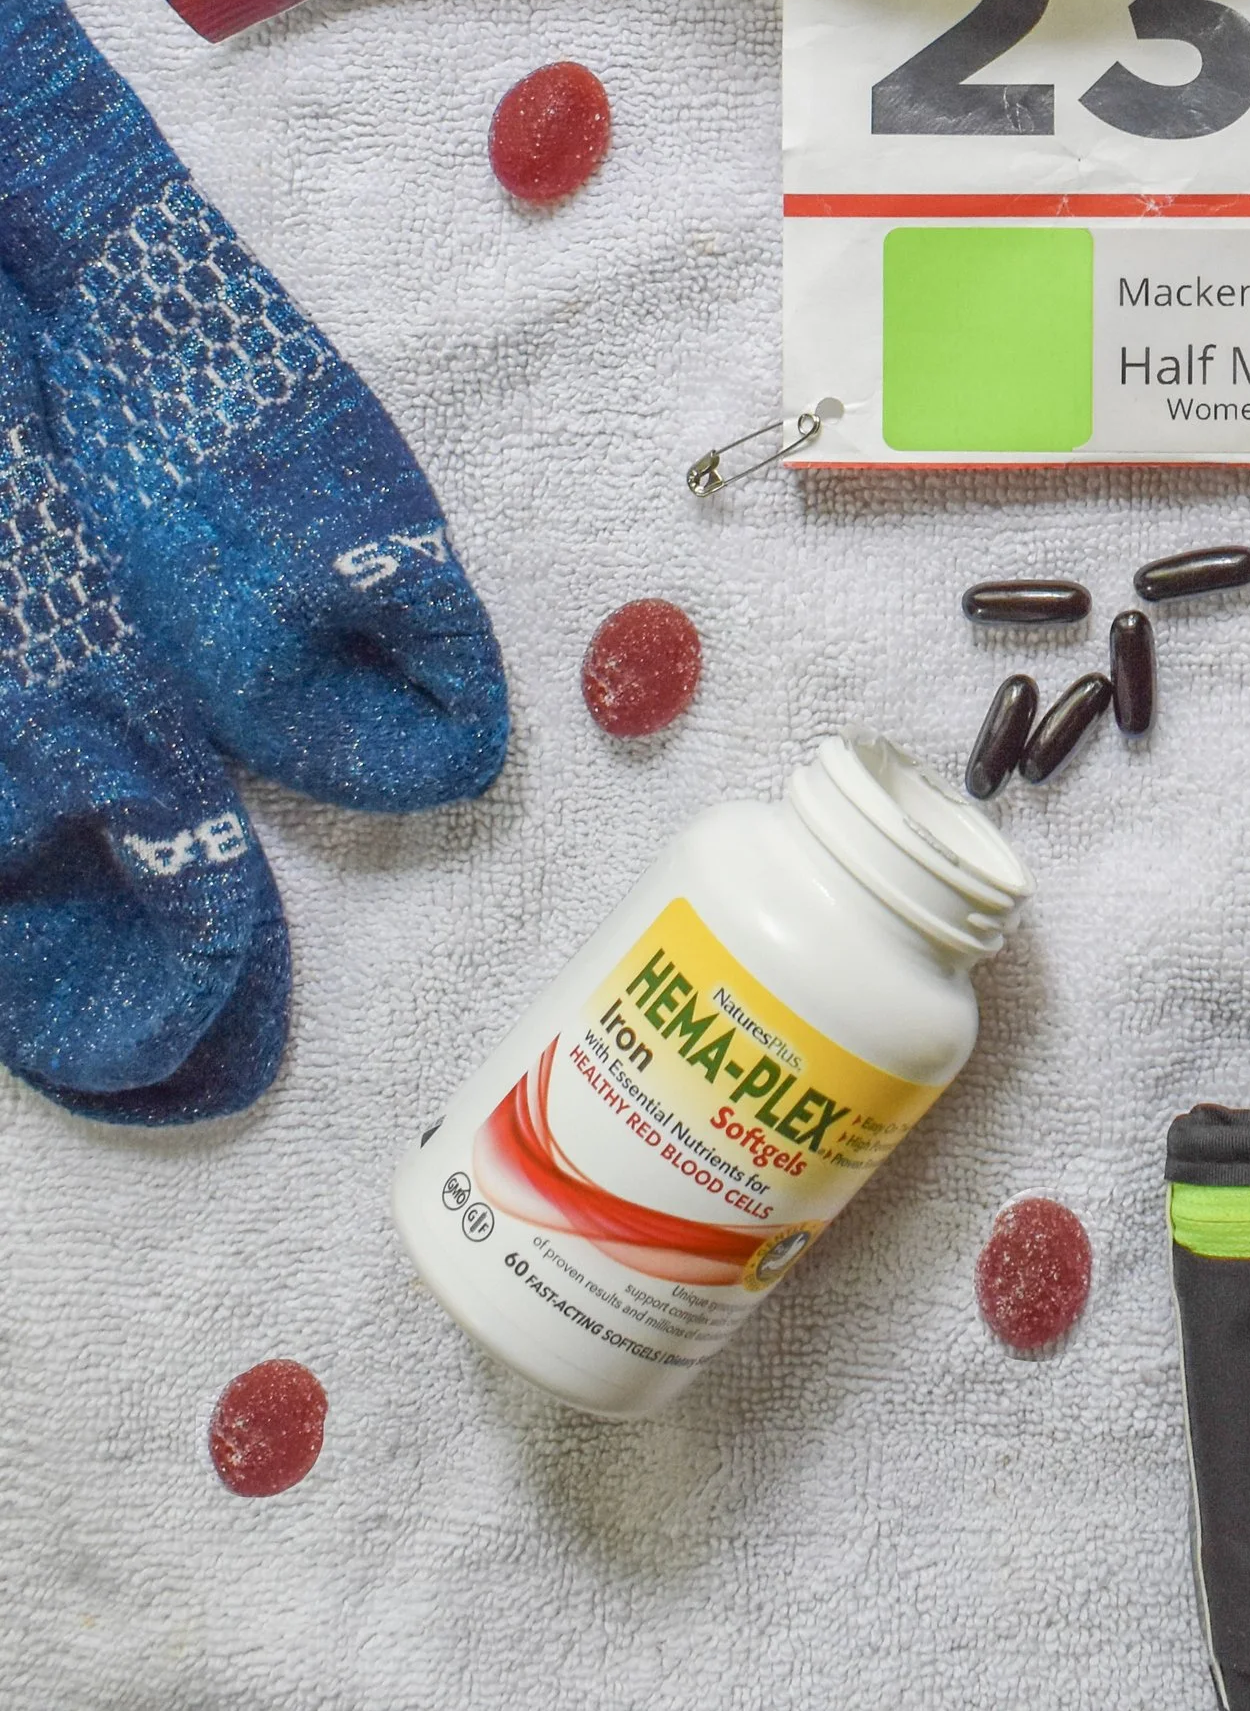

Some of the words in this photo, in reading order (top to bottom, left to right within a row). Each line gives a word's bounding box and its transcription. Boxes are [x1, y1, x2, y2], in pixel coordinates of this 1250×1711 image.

[1120, 343, 1217, 386] Half
[599, 997, 654, 1073] Iron
[625, 948, 852, 1153] HEMA-PLEX
[569, 1044, 631, 1116] HEALTHY
[625, 1111, 662, 1148] RED
[659, 1141, 724, 1194] BLOOD
[723, 1188, 775, 1221] CELLS
[584, 1028, 610, 1064] with
[608, 1058, 674, 1127] Essential
[670, 1120, 745, 1183] Nutrients
[744, 1173, 771, 1196] for
[710, 1105, 808, 1177] Softgels
[503, 1251, 530, 1278] 60
[524, 1274, 604, 1336] FAST-ACTING
[601, 1328, 661, 1363] SOFTGELS
[532, 1235, 547, 1251] of
[542, 1247, 586, 1285] proven
[584, 1279, 623, 1310] results
[621, 1302, 648, 1323] and
[645, 1315, 690, 1340] millions
[624, 1283, 670, 1316] support
[669, 1307, 709, 1327] complex
[671, 1284, 709, 1310] Unique
